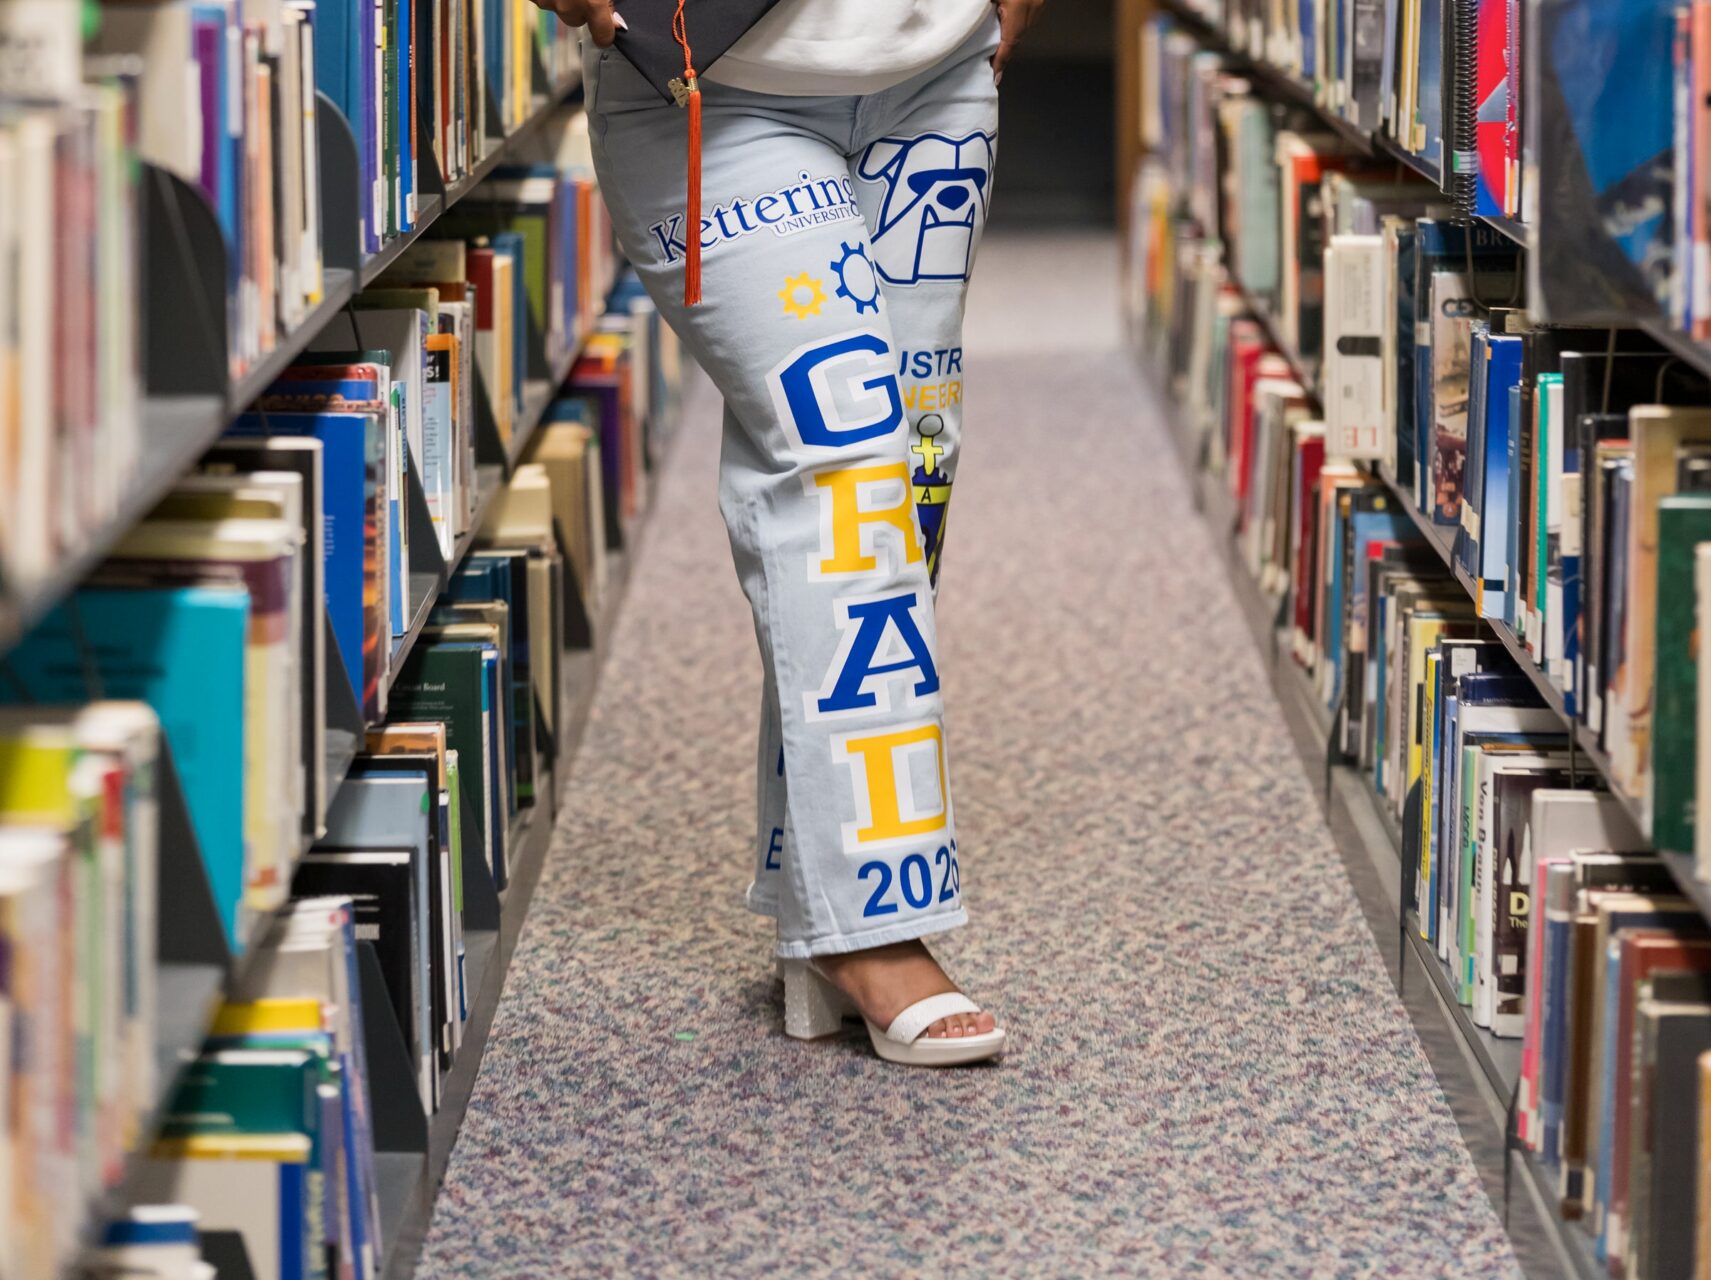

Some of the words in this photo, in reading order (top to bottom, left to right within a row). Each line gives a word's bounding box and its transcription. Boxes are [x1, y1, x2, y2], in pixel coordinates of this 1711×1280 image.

[652, 172, 860, 264] Kettering
[775, 206, 852, 234] UNIVERSITY
[903, 381, 962, 411] NEER
[920, 487, 932, 503] A
[1478, 780, 1488, 820] Von
[857, 837, 960, 918] 2026
